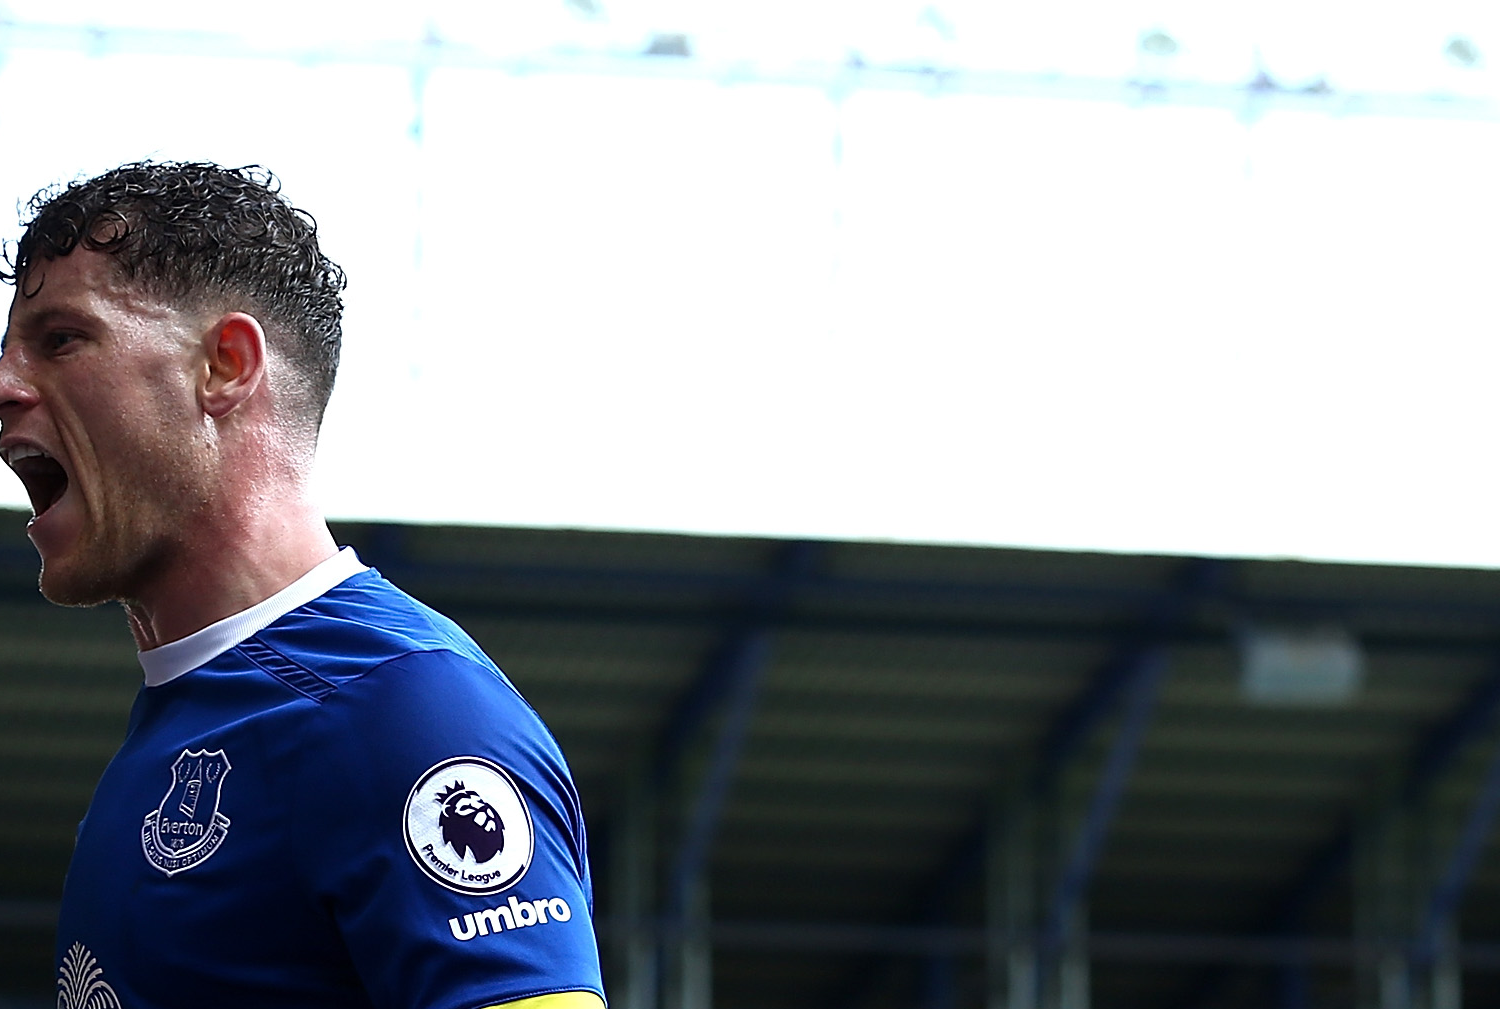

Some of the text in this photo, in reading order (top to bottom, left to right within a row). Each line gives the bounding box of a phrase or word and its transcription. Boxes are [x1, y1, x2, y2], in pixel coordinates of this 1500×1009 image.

[160, 818, 203, 836] Everton
[181, 834, 220, 867] OPTIMUM
[422, 843, 501, 884] Premier League
[449, 896, 572, 941] umbro
